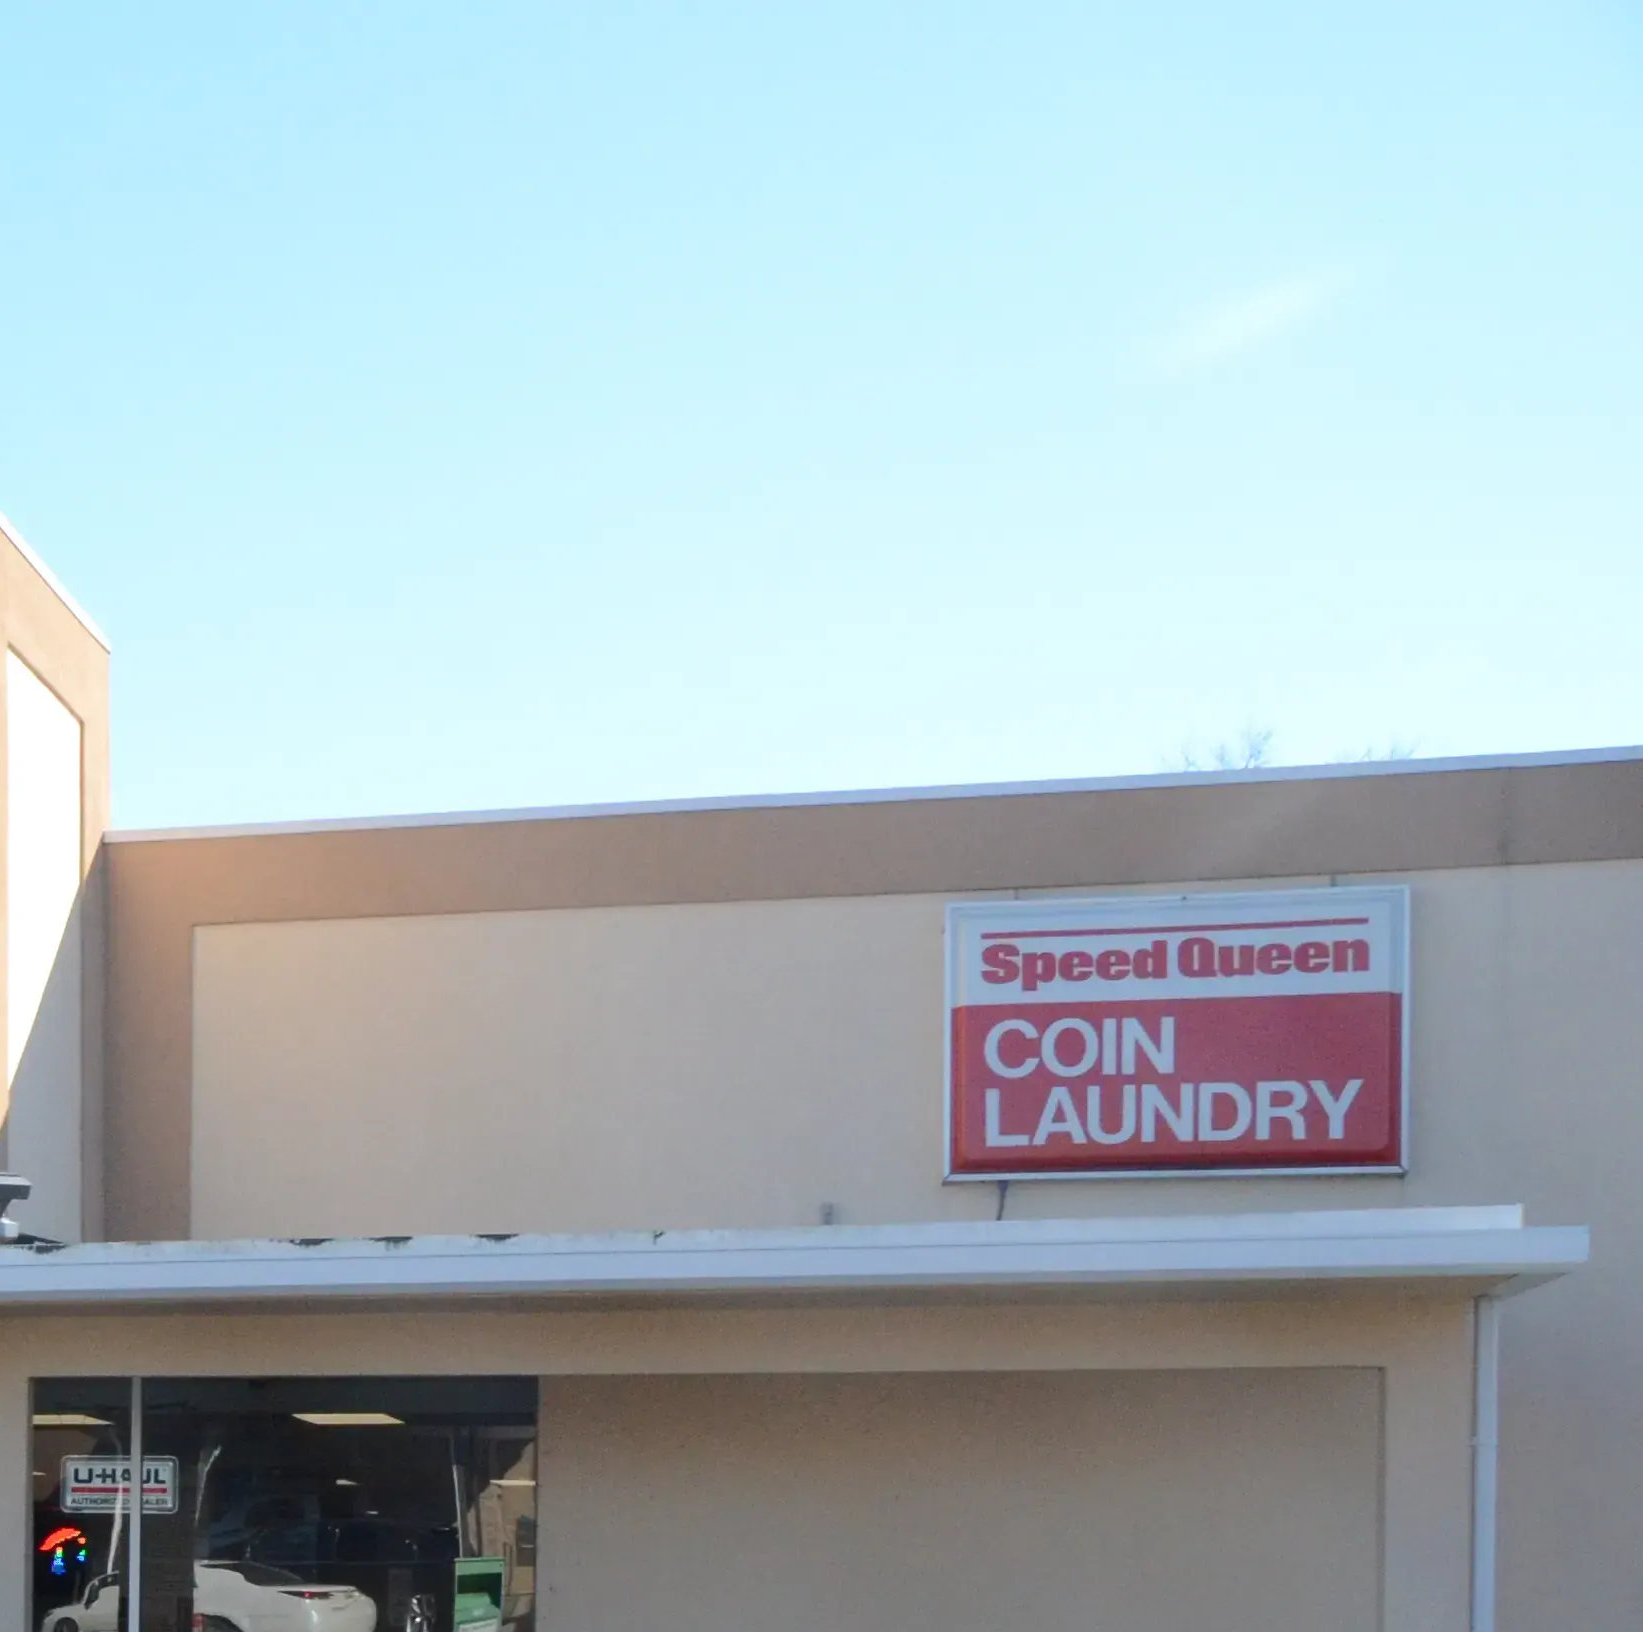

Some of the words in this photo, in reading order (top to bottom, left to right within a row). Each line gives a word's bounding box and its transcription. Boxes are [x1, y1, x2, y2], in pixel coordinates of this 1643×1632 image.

[980, 939, 1168, 992] Speed
[1177, 936, 1370, 979] Queen
[983, 1016, 1176, 1079] COIN
[984, 1078, 1365, 1148] LAUNDRY
